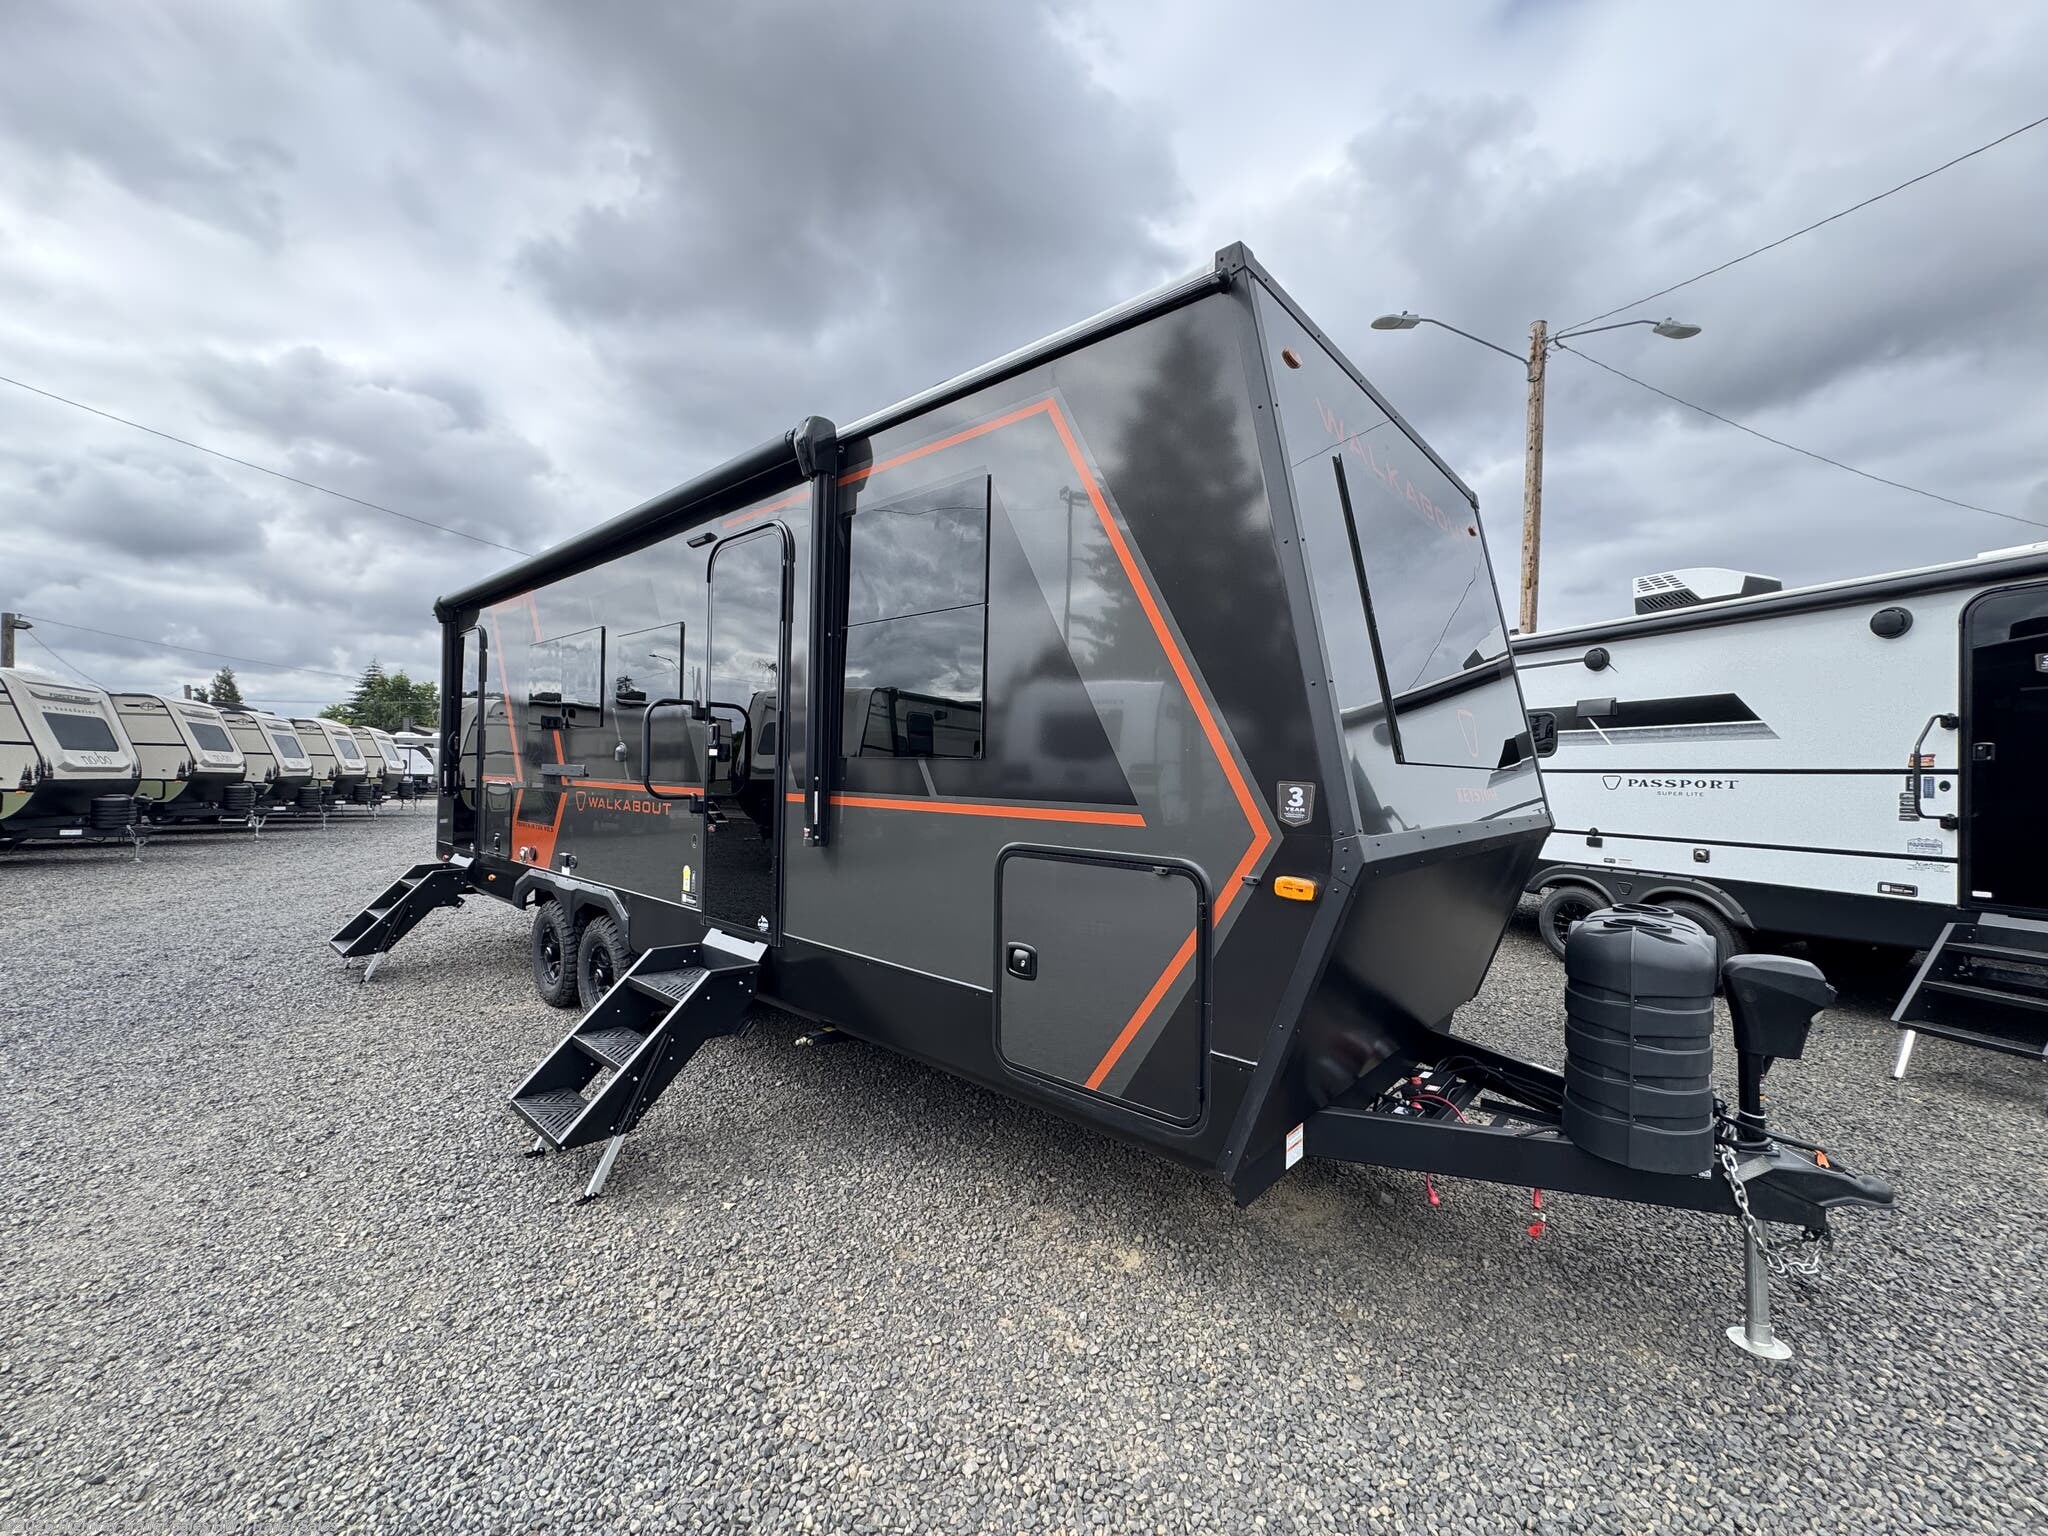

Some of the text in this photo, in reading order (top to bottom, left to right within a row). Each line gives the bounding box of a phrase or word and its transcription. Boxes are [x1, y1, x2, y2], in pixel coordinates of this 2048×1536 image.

[1627, 778, 1740, 790] PASSPORT
[588, 796, 672, 816] WALKABOUT
[1287, 786, 1304, 807] 3
